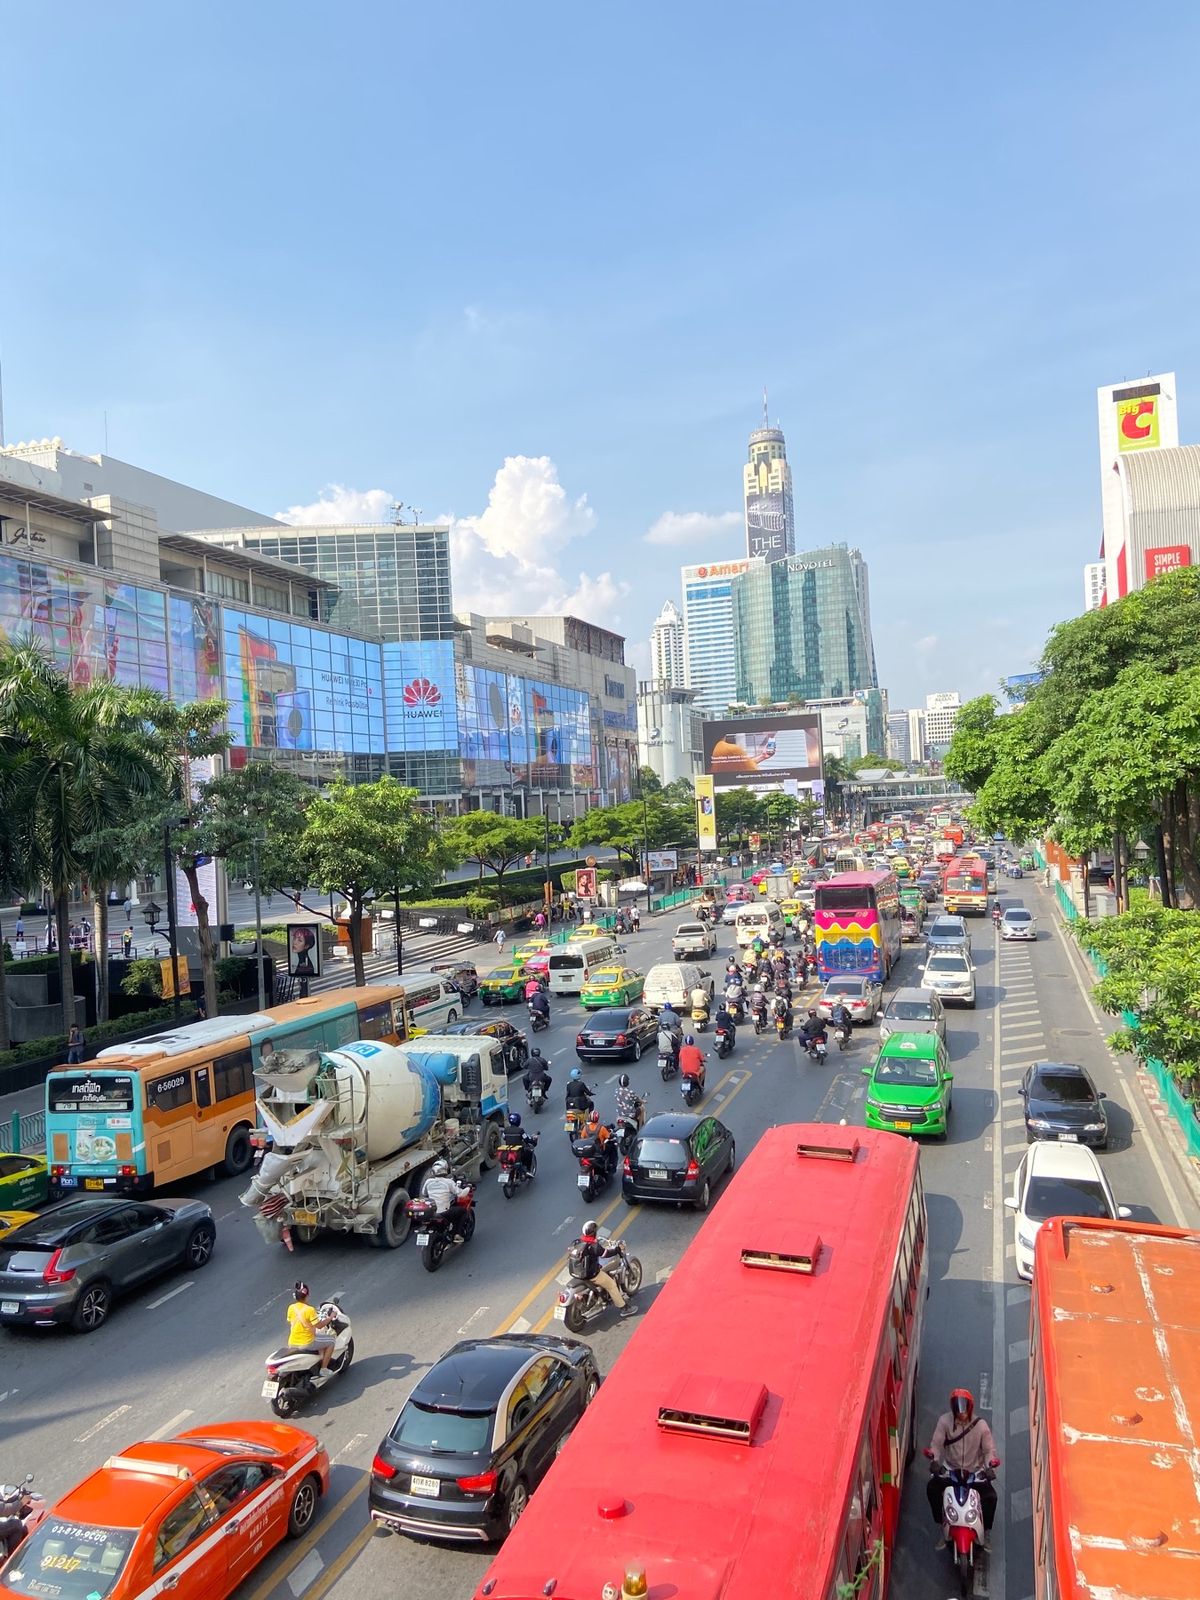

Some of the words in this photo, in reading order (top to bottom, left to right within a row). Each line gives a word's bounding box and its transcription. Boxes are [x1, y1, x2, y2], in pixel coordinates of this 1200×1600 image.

[1119, 404, 1140, 416] Big
[1121, 401, 1154, 440] C
[752, 535, 781, 549] THE
[787, 559, 834, 572] NOVOTEL
[1153, 552, 1181, 566] SIMPLE
[709, 562, 749, 577] Amari
[1154, 565, 1181, 574] EAS
[403, 710, 442, 719] HUAWEI
[157, 1076, 185, 1093] 6-56029
